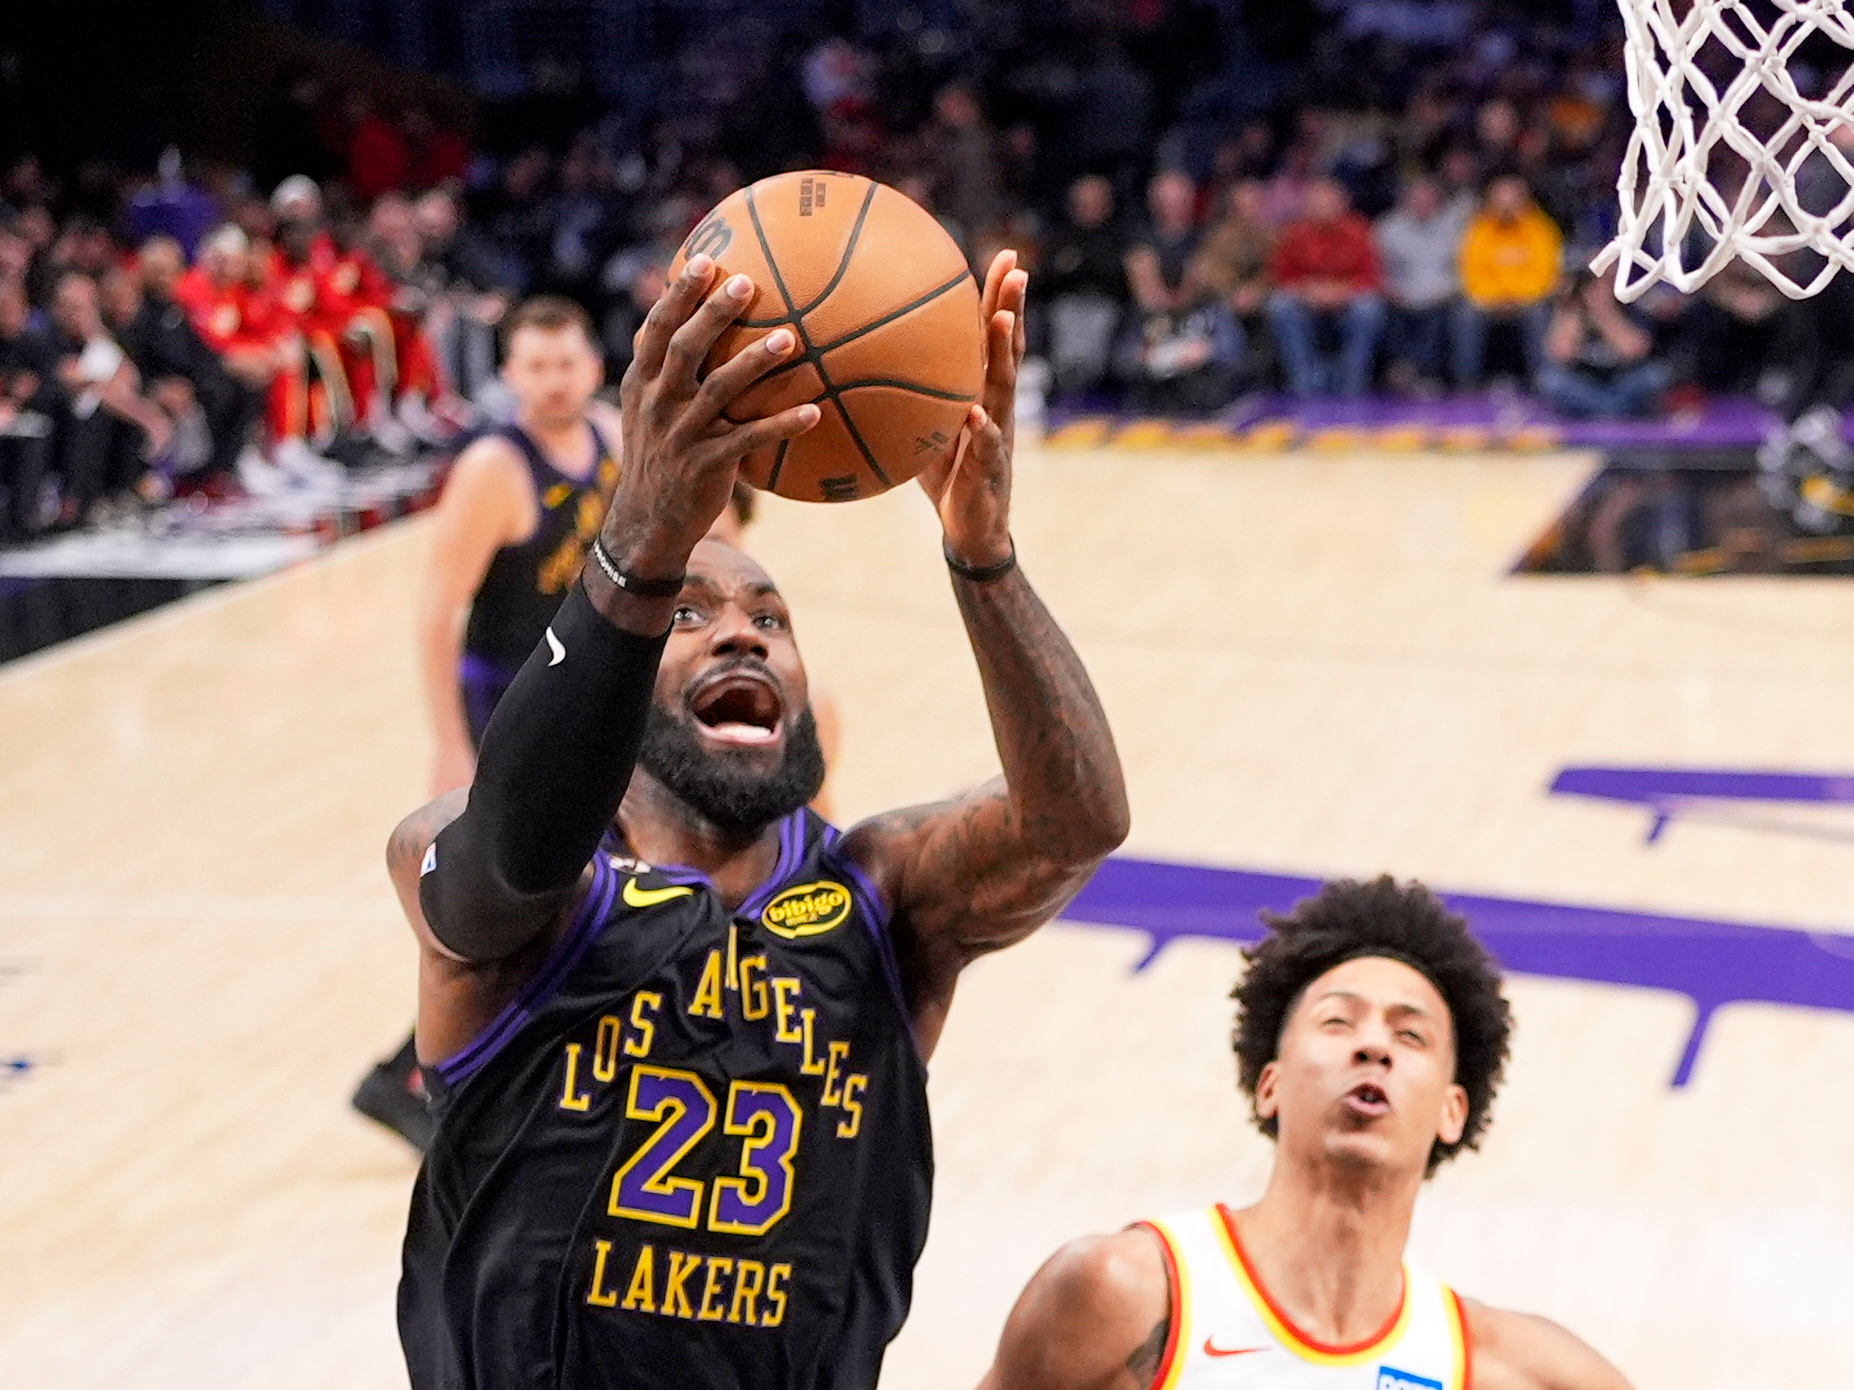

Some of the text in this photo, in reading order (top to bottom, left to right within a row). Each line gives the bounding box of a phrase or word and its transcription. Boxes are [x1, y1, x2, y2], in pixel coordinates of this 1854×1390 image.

[768, 891, 844, 923] bibigo
[559, 990, 662, 1112] LOS
[607, 1063, 804, 1237] 23
[586, 1238, 793, 1328] LAKERS
